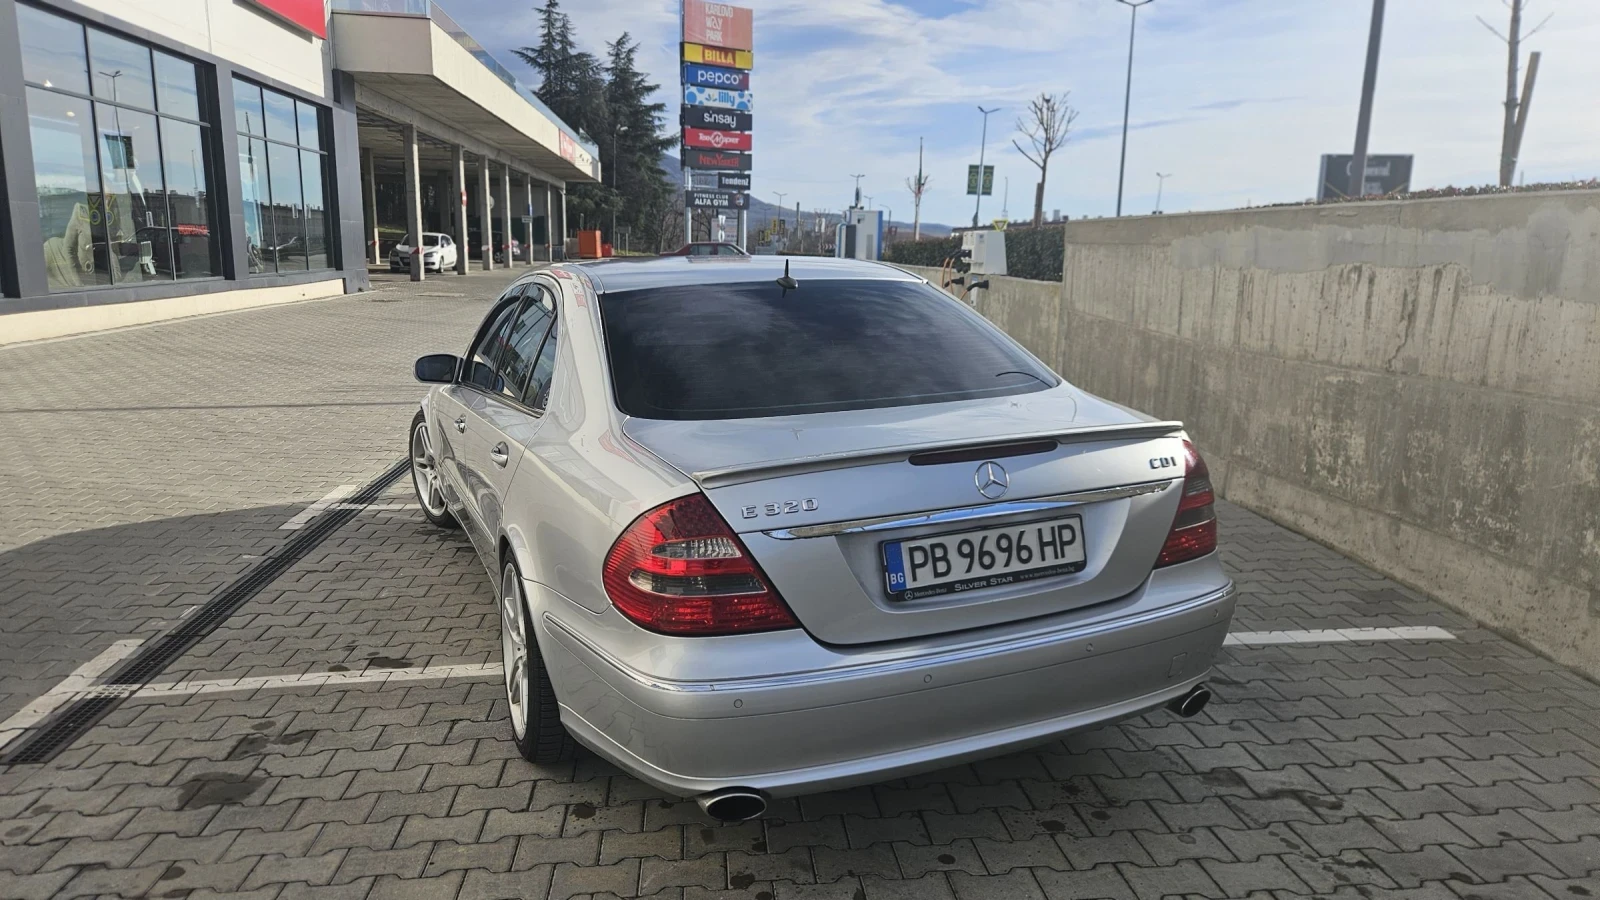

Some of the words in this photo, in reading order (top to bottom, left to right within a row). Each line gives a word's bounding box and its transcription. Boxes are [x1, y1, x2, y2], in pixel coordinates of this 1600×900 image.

[705, 3, 734, 18] KARLOVO
[705, 29, 723, 42] PARK
[704, 49, 735, 65] BILLA
[718, 91, 735, 107] lilly
[694, 198, 712, 206] ALFA
[713, 199, 729, 207] GYM
[1149, 456, 1177, 469] CDI
[741, 504, 758, 519] E
[764, 497, 819, 517] 320
[908, 542, 952, 583] PB
[957, 529, 1033, 574] 9696
[1037, 523, 1077, 562] HP
[890, 572, 905, 585] BG
